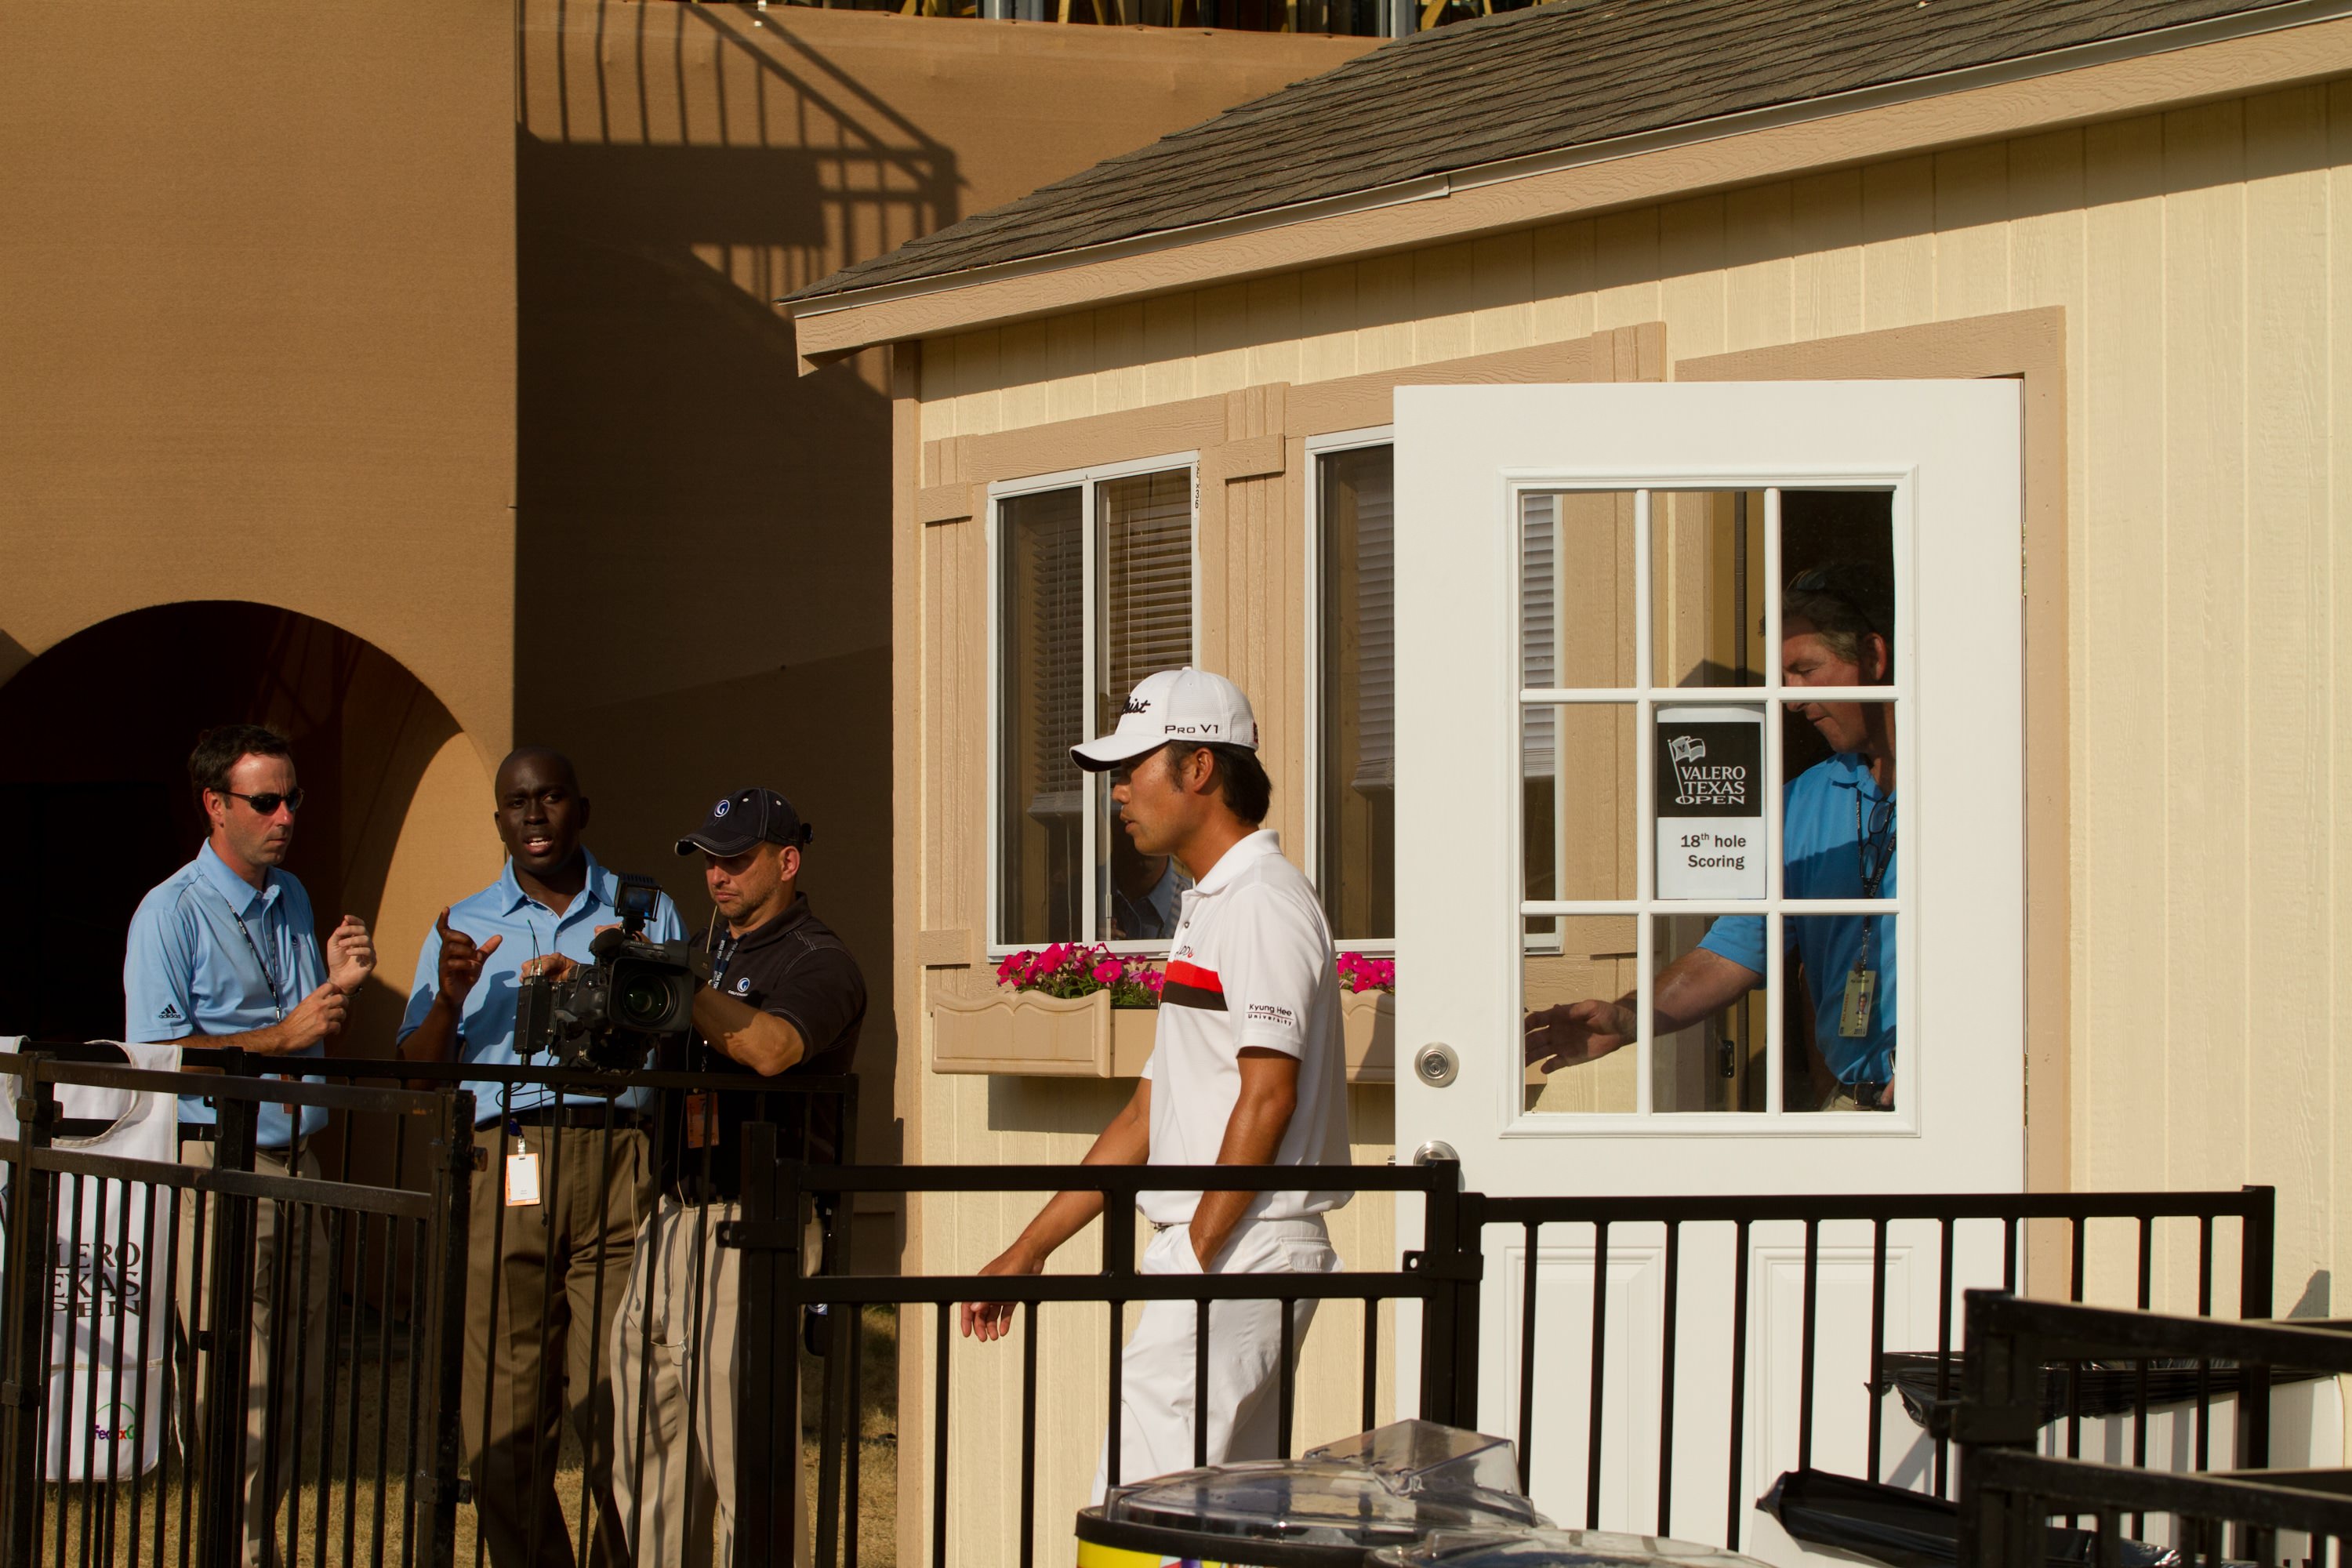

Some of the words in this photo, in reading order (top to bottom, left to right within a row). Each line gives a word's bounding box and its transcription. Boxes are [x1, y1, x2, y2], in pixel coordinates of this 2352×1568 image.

[1200, 724, 1219, 734] V1
[1680, 766, 1746, 780] VALERO
[1683, 781, 1745, 795] TEXAS
[1675, 795, 1745, 805] OPEN
[1680, 833, 1710, 848] 18th
[1714, 834, 1746, 848] hole
[1688, 855, 1745, 870] Scoring
[1869, 884, 1878, 897] PGA
[1875, 867, 1885, 884] TOUR
[1249, 1004, 1275, 1014] Kyung
[1276, 1006, 1292, 1016] Hee
[1248, 1013, 1292, 1026] University
